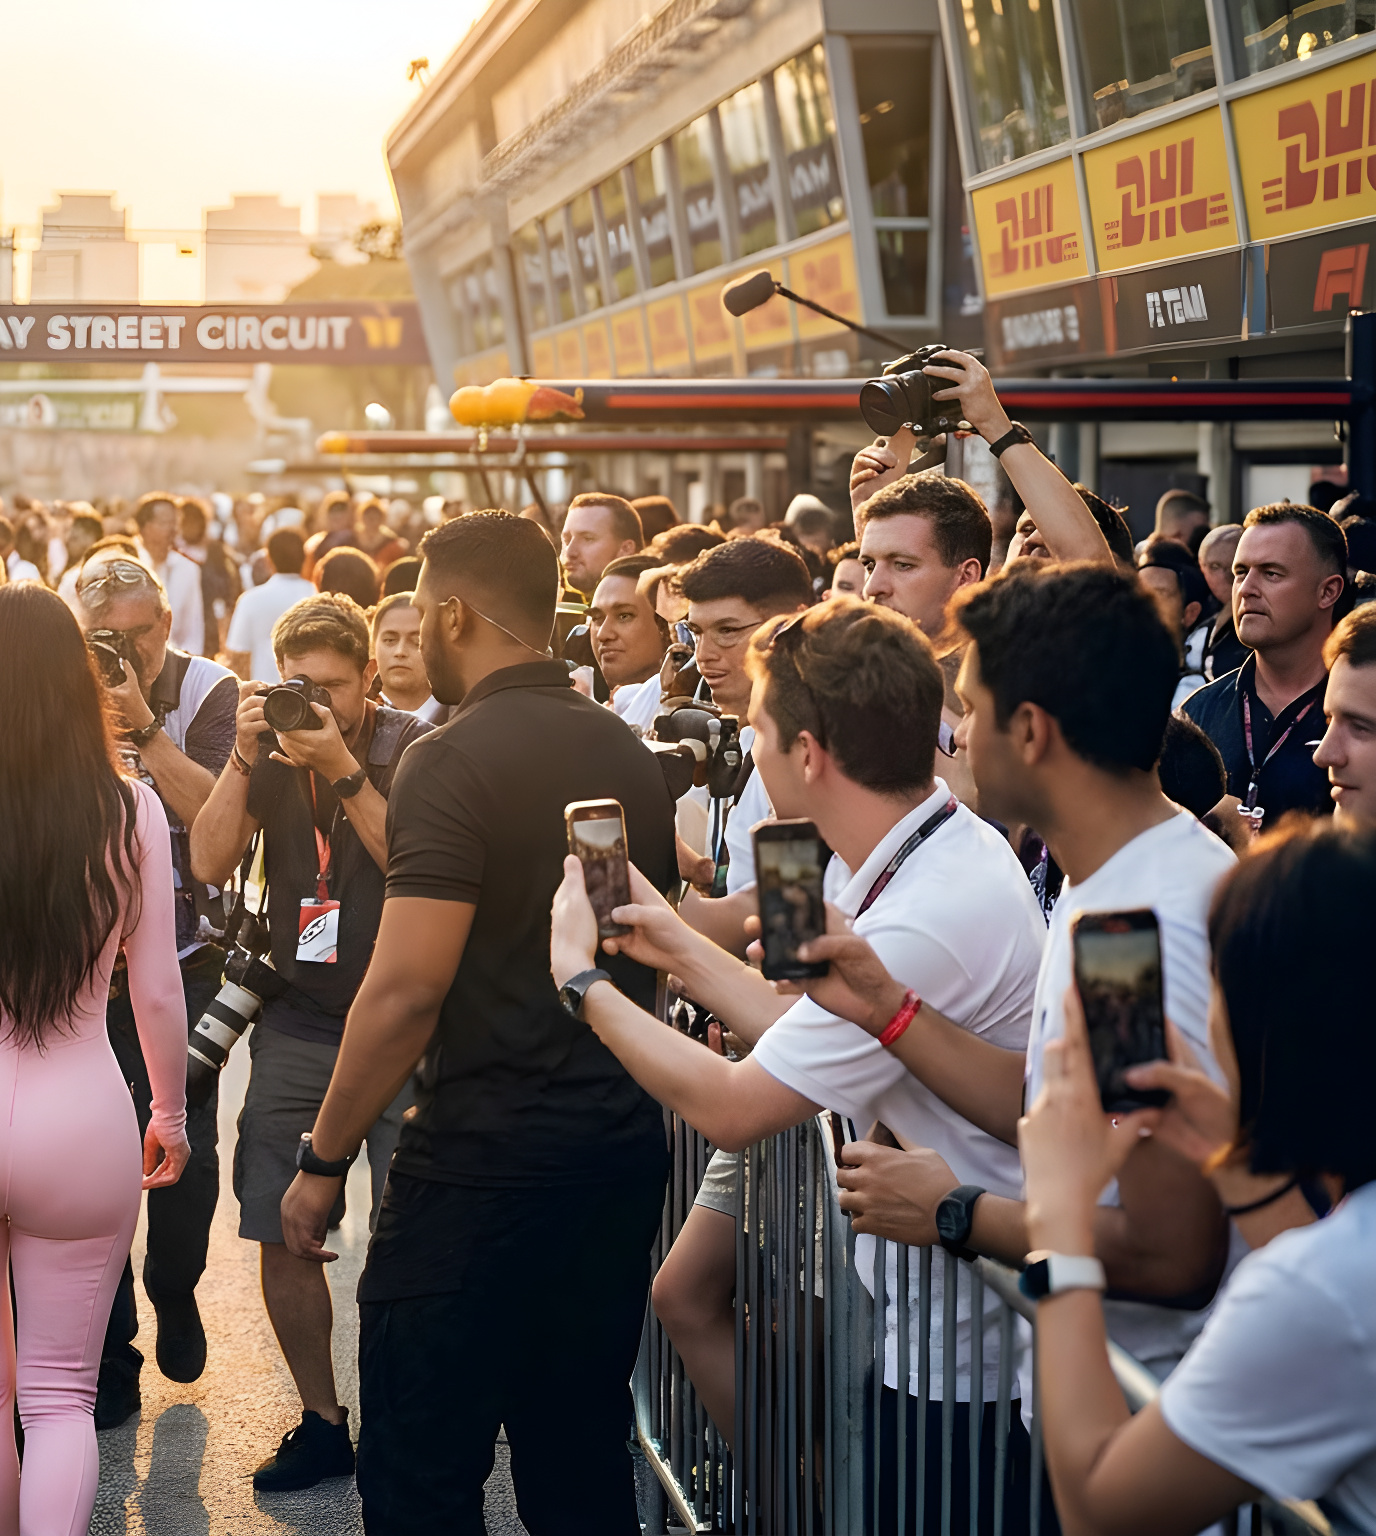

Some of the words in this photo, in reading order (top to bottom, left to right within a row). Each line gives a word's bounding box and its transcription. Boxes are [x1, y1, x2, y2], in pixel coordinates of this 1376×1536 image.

[995, 183, 1076, 275] DHL
[1116, 137, 1207, 248] DHL
[47, 315, 186, 350] STREET
[196, 315, 353, 350] CIRCUIT
